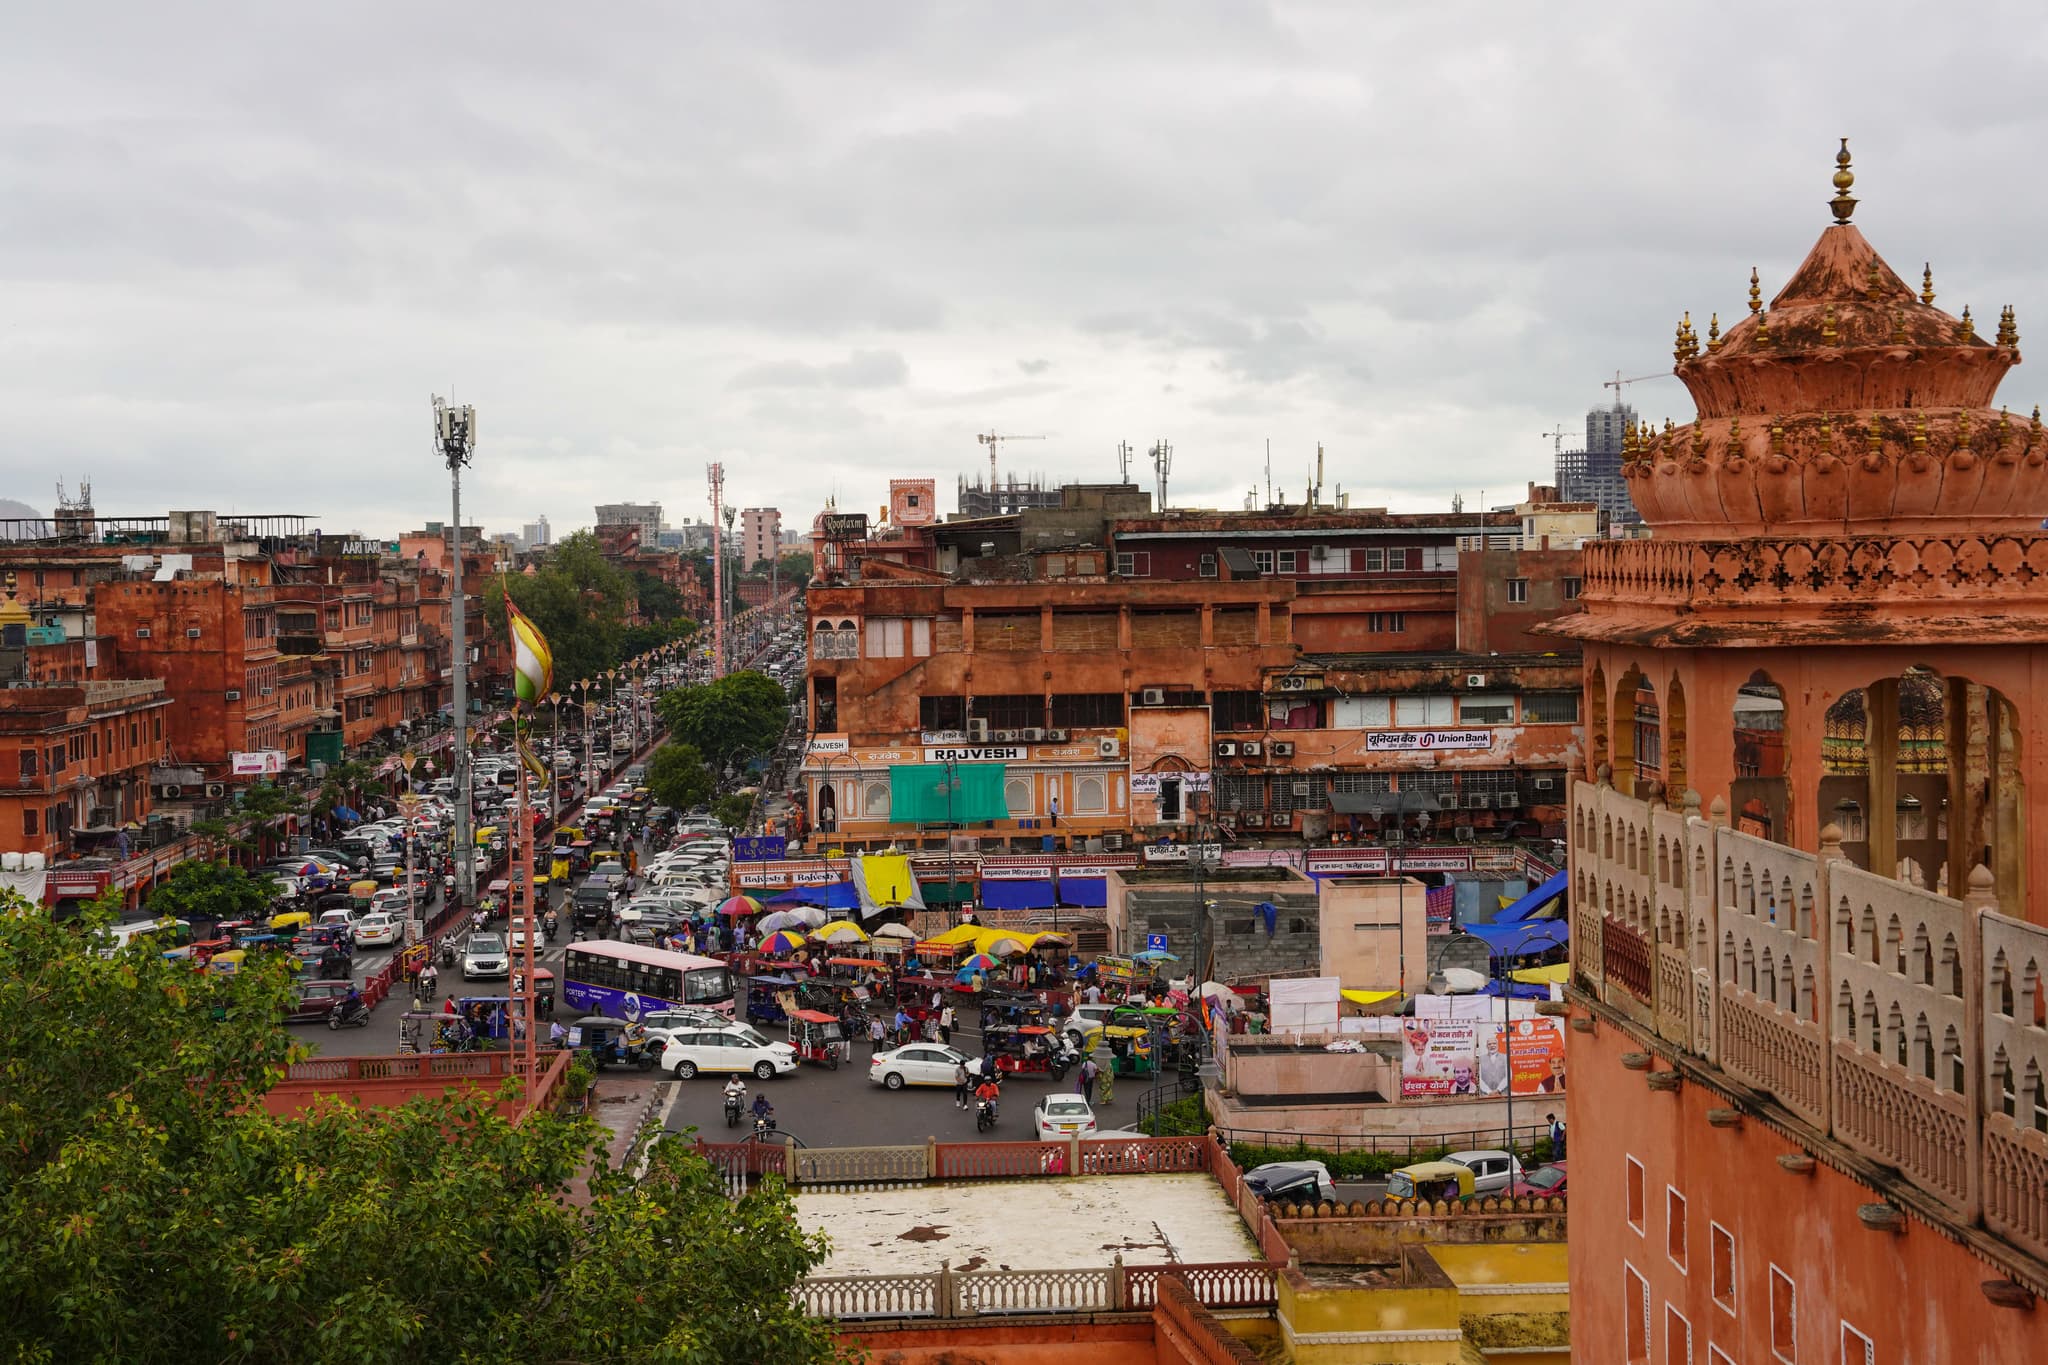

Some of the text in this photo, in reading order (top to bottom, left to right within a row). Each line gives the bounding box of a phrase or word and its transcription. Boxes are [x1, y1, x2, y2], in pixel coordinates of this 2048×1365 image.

[825, 516, 863, 534] Rooplaxmi
[1438, 733, 1488, 743] Union Bank
[811, 742, 844, 750] RAJVESH
[935, 748, 1018, 760] RAJVESH
[744, 875, 781, 884] Rajvesh
[797, 872, 834, 882] Rajvesh
